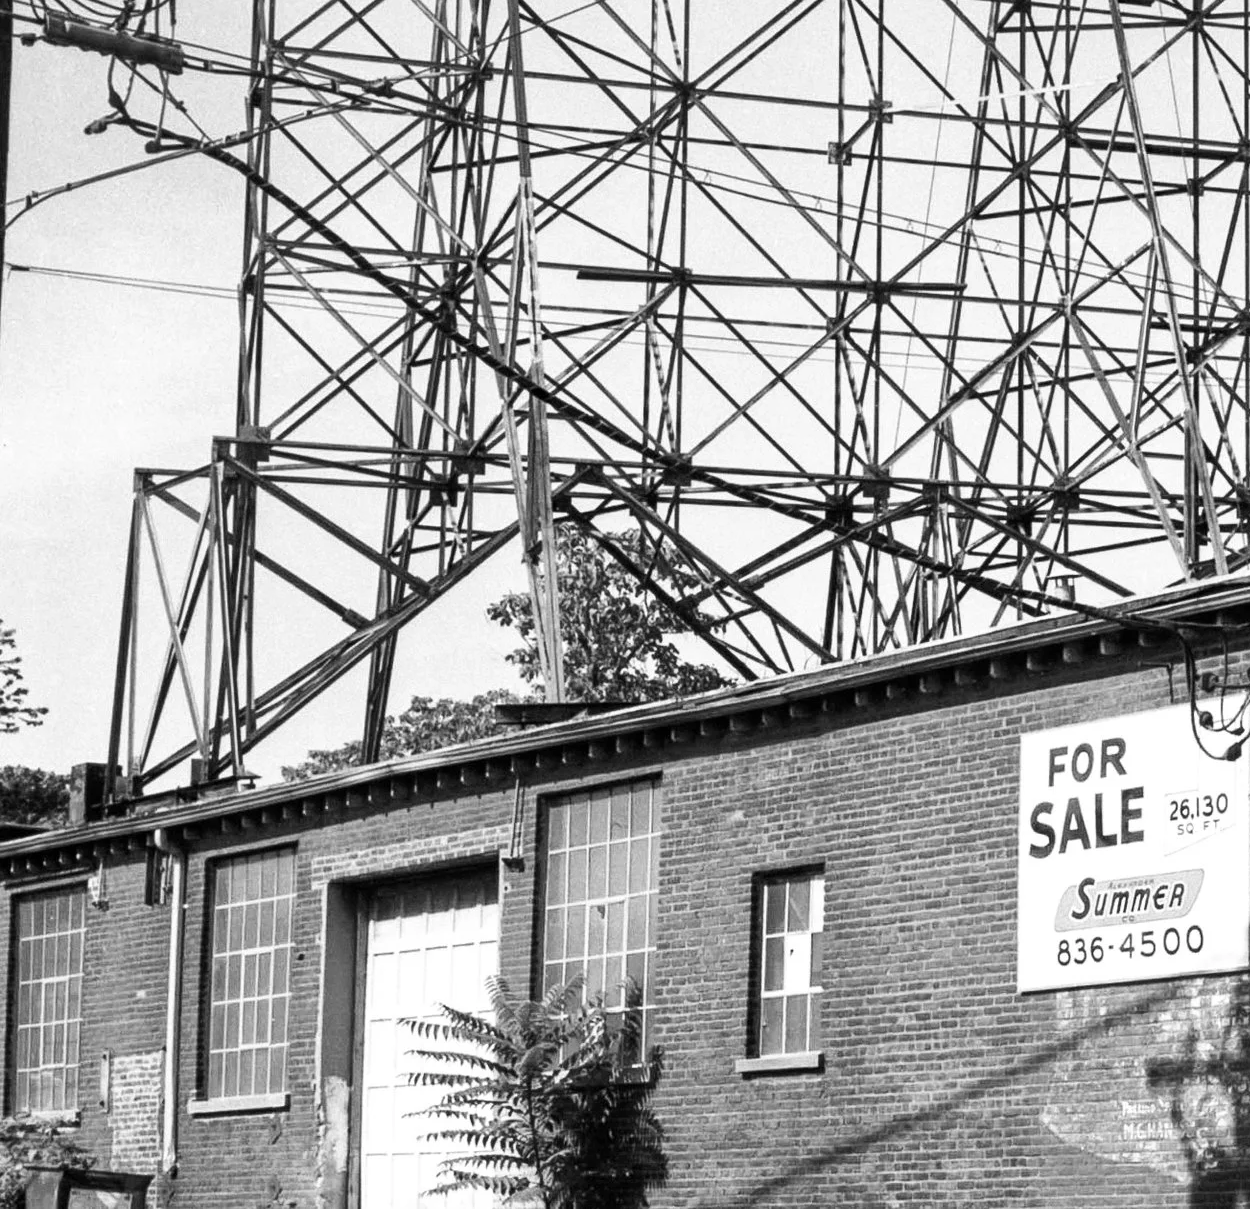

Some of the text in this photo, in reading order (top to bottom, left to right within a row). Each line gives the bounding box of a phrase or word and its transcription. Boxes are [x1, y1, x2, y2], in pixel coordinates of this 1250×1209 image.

[1048, 737, 1127, 787] FOR
[1029, 786, 1144, 858] SALE
[1057, 925, 1204, 966] 836-4500
